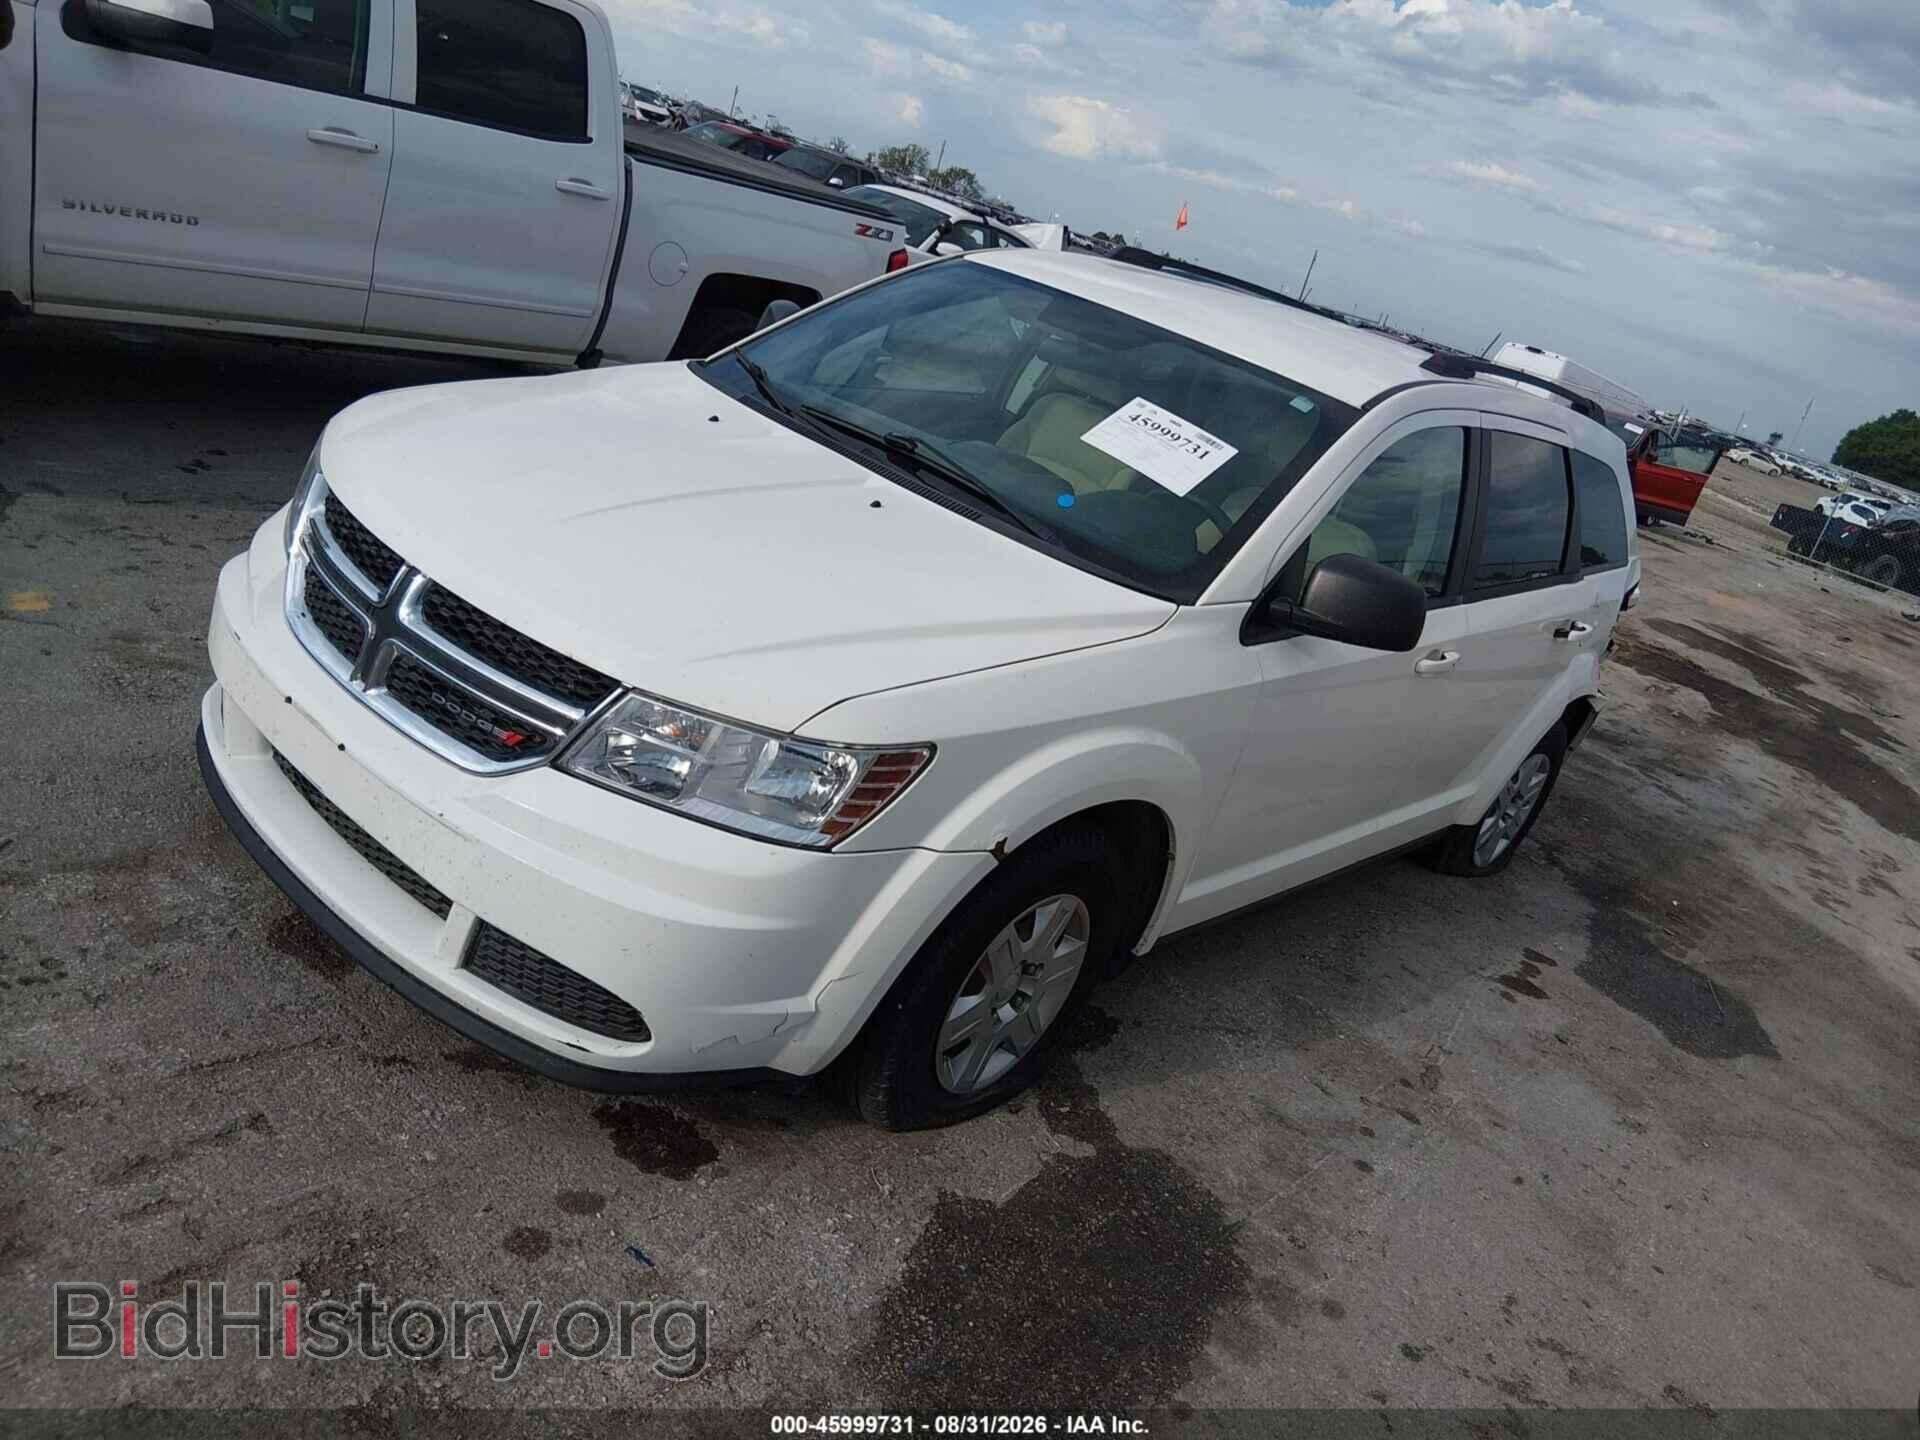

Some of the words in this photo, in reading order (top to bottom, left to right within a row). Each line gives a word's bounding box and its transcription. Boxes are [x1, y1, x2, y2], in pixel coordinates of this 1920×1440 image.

[62, 199, 200, 227] SILVERADO
[1128, 413, 1211, 460] 45999731
[431, 692, 508, 740] DODGE
